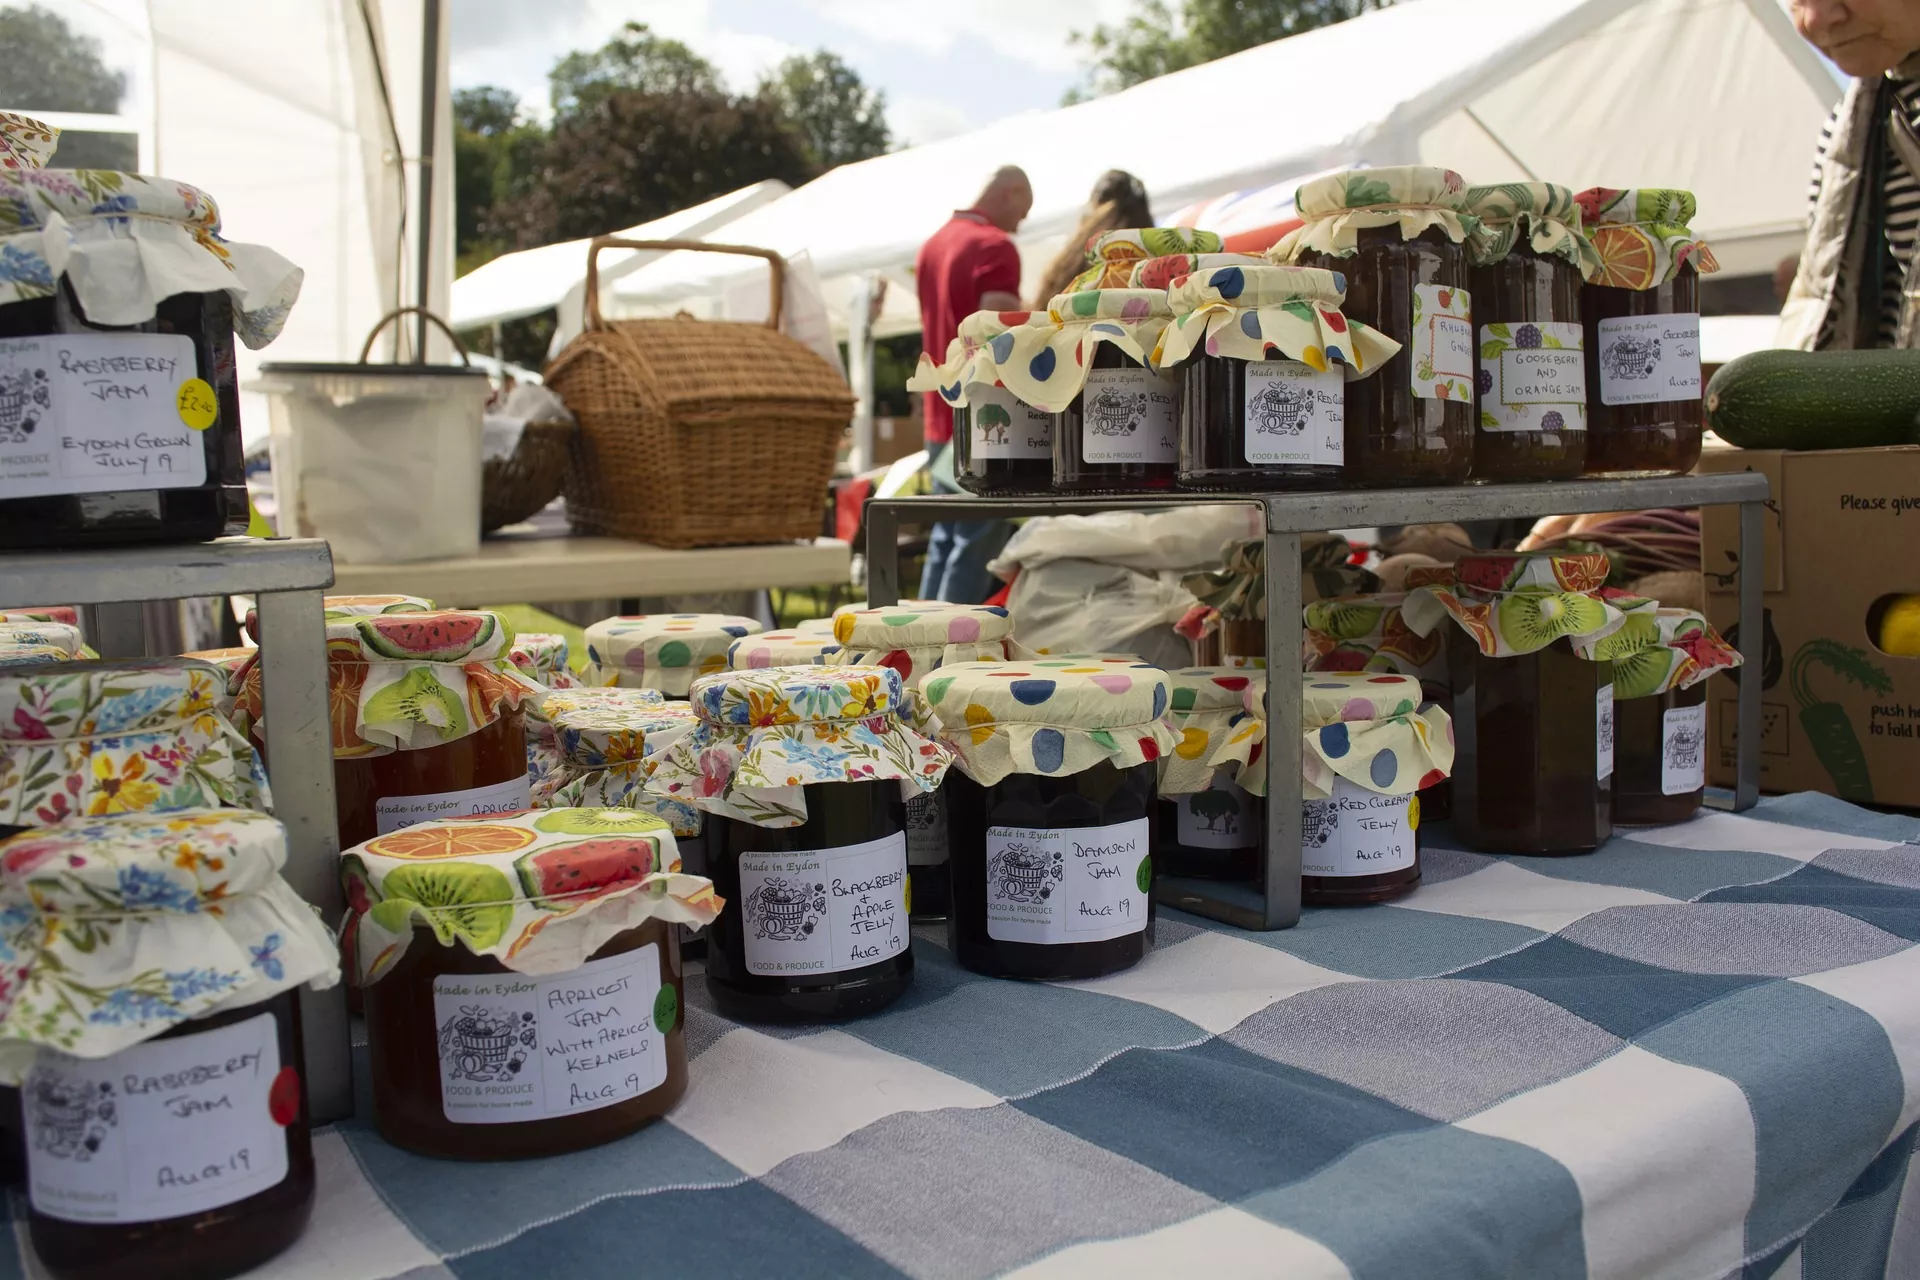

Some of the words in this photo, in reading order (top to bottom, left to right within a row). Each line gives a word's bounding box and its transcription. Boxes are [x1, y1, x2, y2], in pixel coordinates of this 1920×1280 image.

[58, 350, 178, 383] RASPBERRY
[1516, 354, 1578, 366] GOOSEBERRY
[1087, 375, 1106, 384] Made
[1119, 374, 1144, 386] Eydon
[1249, 368, 1273, 377] Made
[1276, 369, 1285, 377] in
[1287, 368, 1312, 380] Eydon
[1536, 368, 1557, 378] AND
[83, 379, 150, 401] JAM
[1150, 392, 1170, 404] RED
[1317, 390, 1332, 404] RED
[1515, 384, 1562, 396] ORANGE
[1566, 384, 1581, 394] JAM
[62, 436, 129, 454] EYDON
[134, 433, 193, 450] GROWN
[92, 452, 148, 475] JULY
[158, 453, 174, 473] 19
[1112, 451, 1143, 459] PRODUCE
[1252, 452, 1272, 460] FOOD
[1273, 452, 1279, 460] &
[1280, 452, 1310, 460] PRODUCE
[1840, 494, 1888, 510] Please
[1891, 495, 1920, 516] give
[1871, 703, 1905, 720] push
[1869, 720, 1884, 735] to
[410, 801, 425, 812] in
[472, 797, 520, 815] APRICOT
[1340, 797, 1366, 810] RED
[1370, 793, 1412, 808] CURRANT
[1357, 817, 1398, 835] JELLY
[987, 827, 1013, 838] Made
[1016, 829, 1025, 838] in
[1028, 830, 1060, 843] Eydon
[800, 849, 816, 857] made
[1071, 838, 1136, 858] DAMSON
[1356, 850, 1384, 860] AUG
[743, 861, 769, 872] Made
[772, 863, 783, 871] in
[787, 859, 820, 874] Eydon
[1086, 862, 1121, 880] JAM
[1302, 864, 1335, 872] PRODUCE
[832, 868, 903, 897] BLACKBERRY
[852, 899, 895, 920] APPLE
[987, 903, 1007, 912] FOOD
[1008, 904, 1015, 912] &
[1017, 906, 1053, 915] PRODUCE
[1078, 901, 1114, 916] AUG
[1118, 898, 1130, 918] 19
[850, 912, 895, 937] JELLY
[850, 944, 880, 960] AUG
[753, 961, 775, 970] FOOD
[776, 962, 783, 970] &
[785, 960, 825, 970] PRODUCE
[474, 984, 491, 996] in
[548, 975, 633, 1009] APRICOT
[564, 1006, 621, 1028] JAM
[545, 1039, 594, 1056] WITH
[598, 1014, 651, 1044] APRICOT
[566, 1039, 648, 1074] KERNELS
[123, 1048, 262, 1095] RASPBERRY
[445, 1085, 472, 1096] FOOD
[475, 1085, 482, 1096] &
[485, 1083, 534, 1096] PRODUCE
[569, 1082, 617, 1106] AUG
[624, 1073, 639, 1092] 19
[164, 1094, 233, 1119] JAM
[230, 1149, 251, 1171] 19
